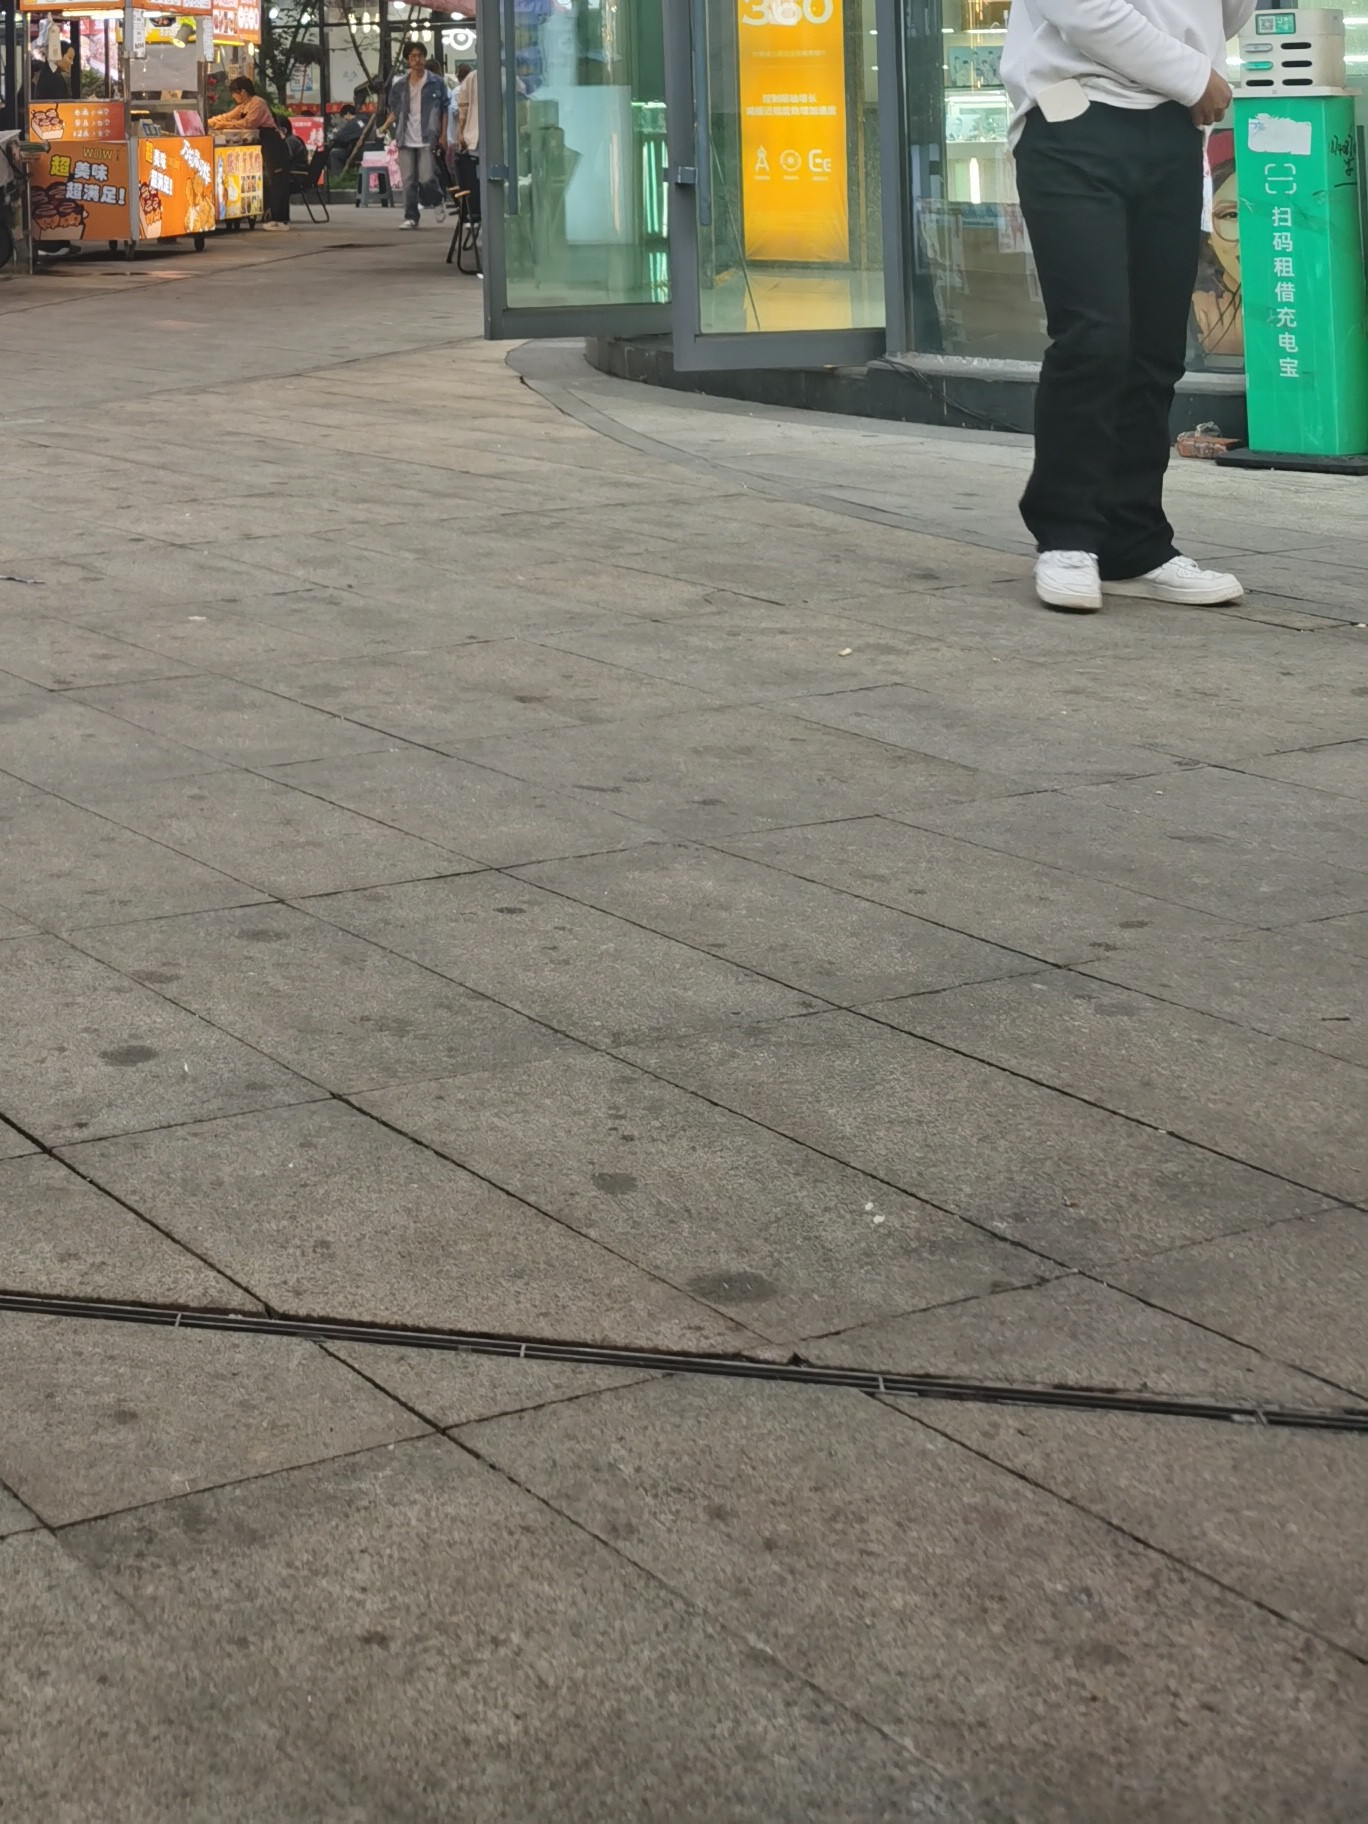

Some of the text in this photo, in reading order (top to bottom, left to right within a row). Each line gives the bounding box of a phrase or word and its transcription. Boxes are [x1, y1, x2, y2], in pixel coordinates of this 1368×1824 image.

[1272, 206, 1299, 377] 扫码租借充电宝
